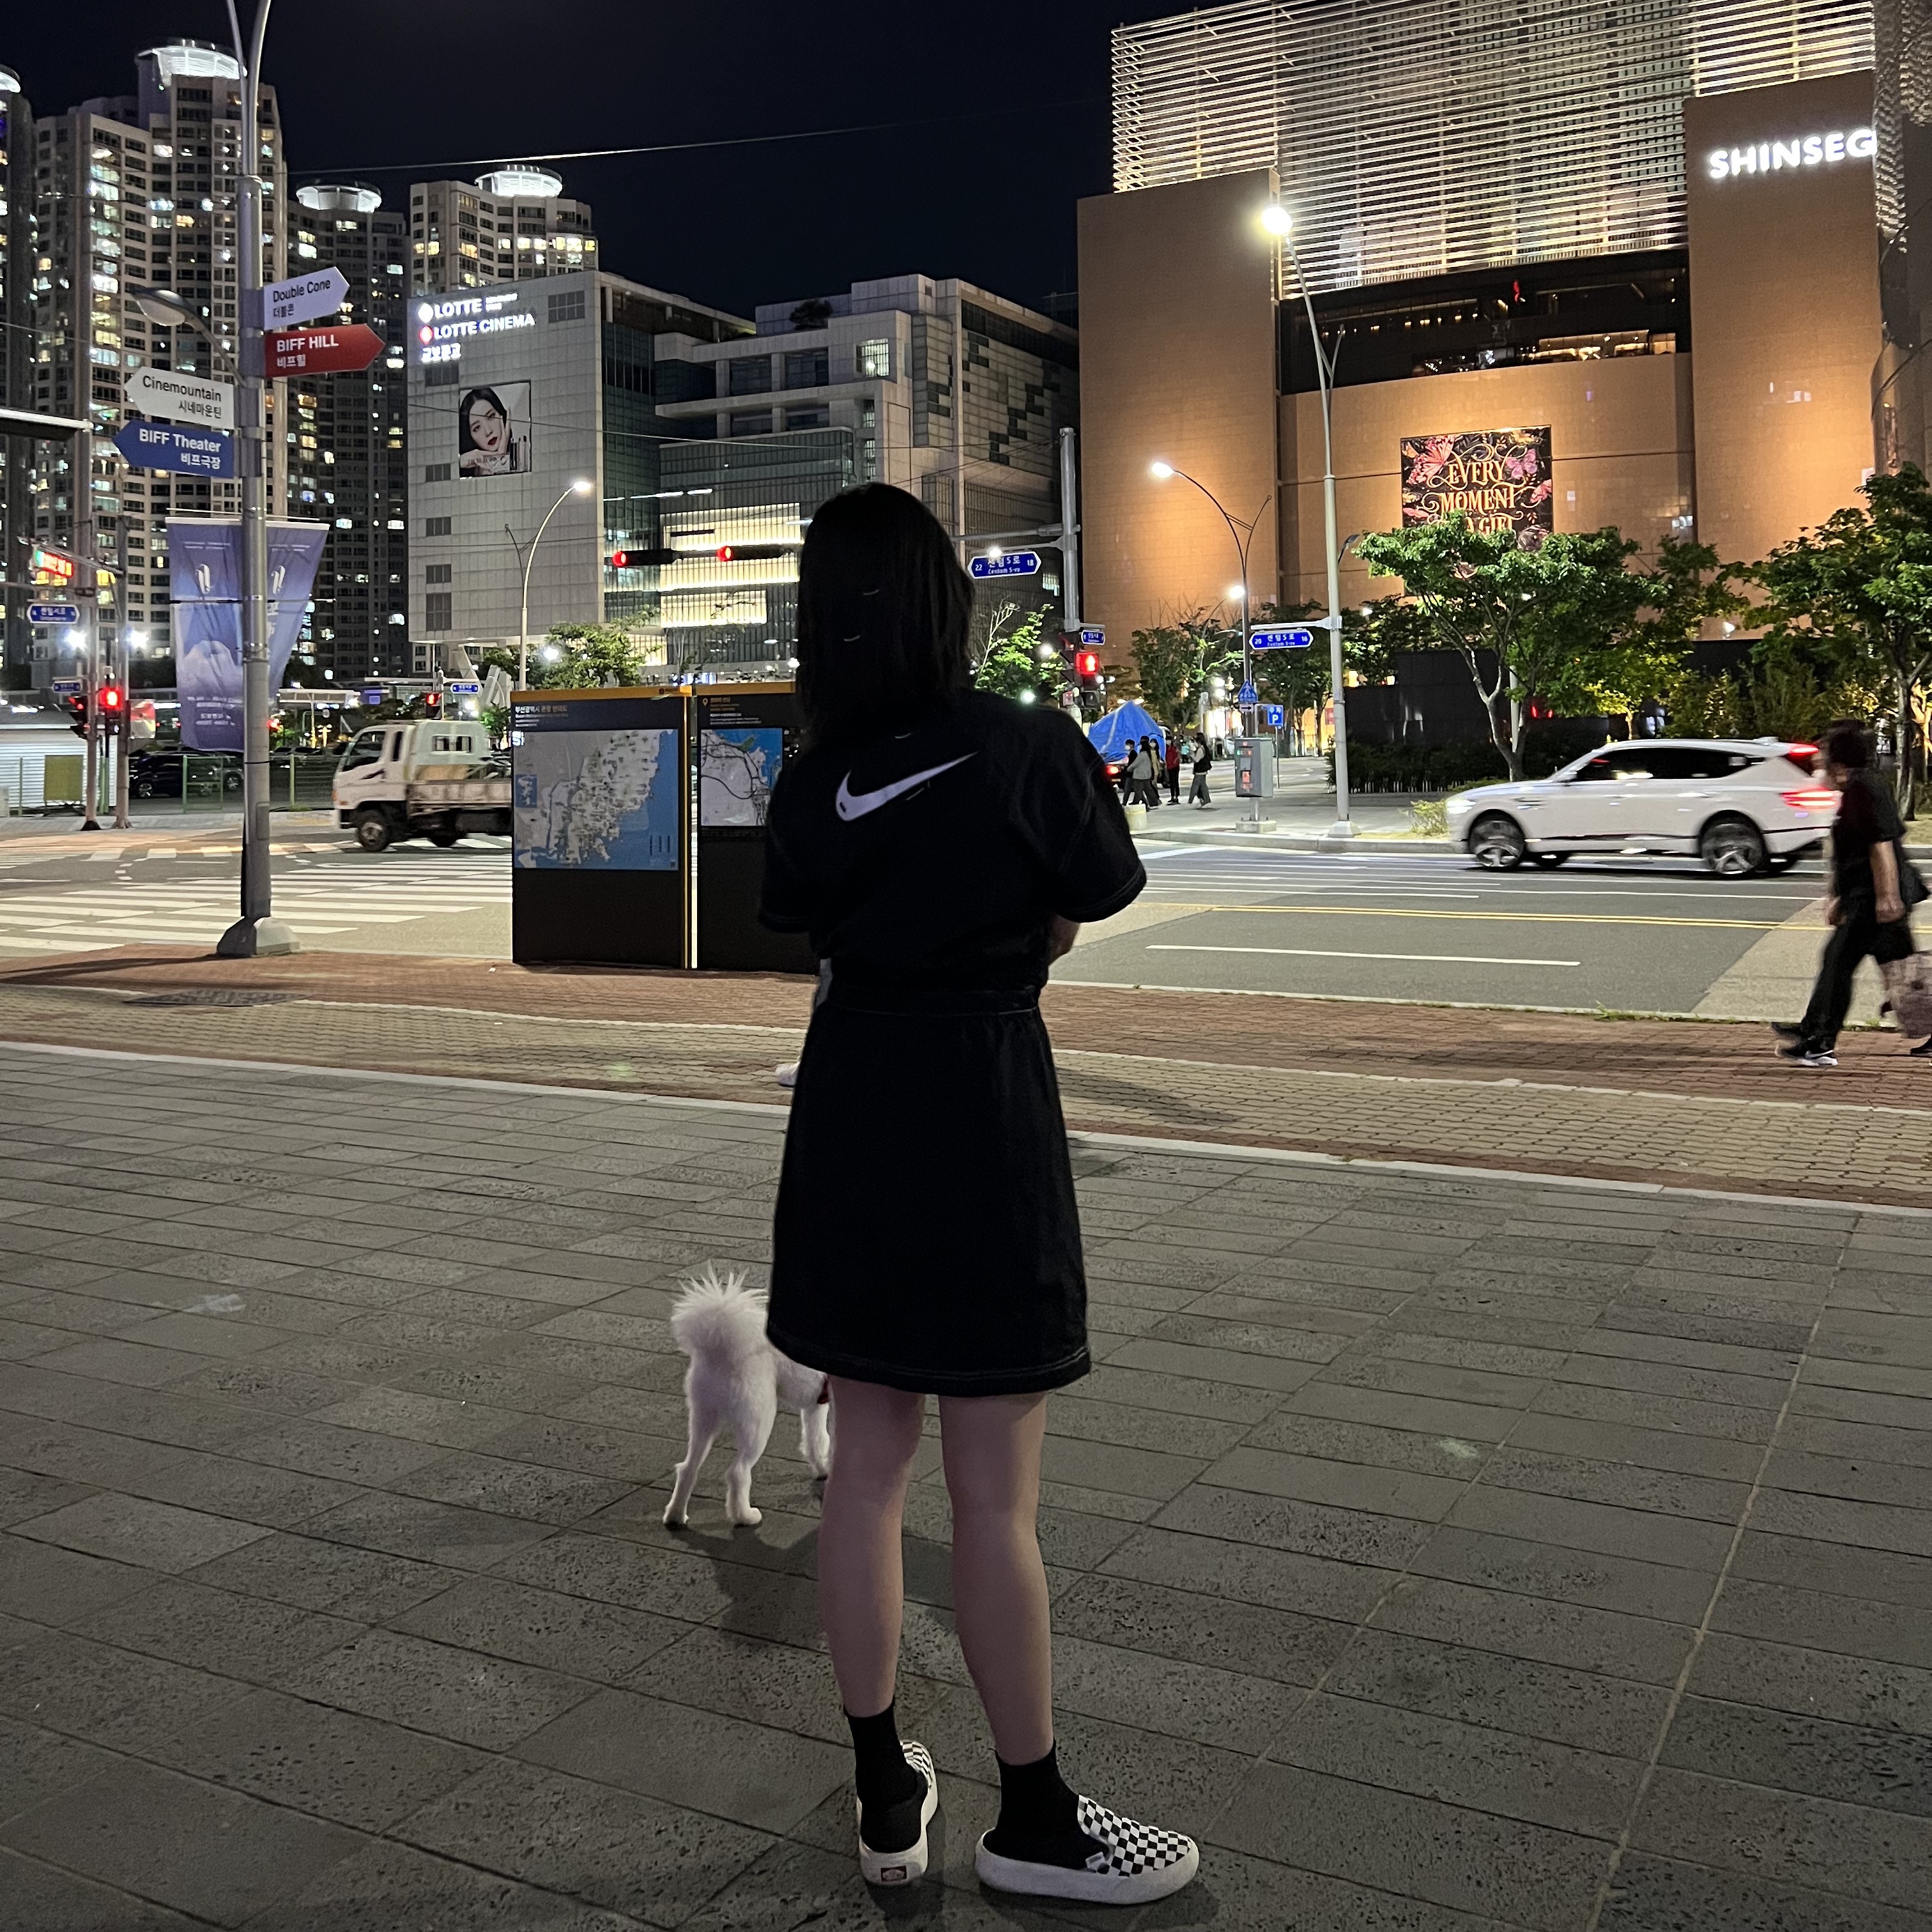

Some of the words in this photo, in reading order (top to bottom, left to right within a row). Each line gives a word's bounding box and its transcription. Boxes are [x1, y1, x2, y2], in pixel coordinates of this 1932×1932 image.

[273, 285, 304, 302] Double
[307, 280, 330, 293] Cone
[273, 303, 294, 318] 더블콘
[434, 298, 482, 319] LOTTE
[434, 321, 477, 339] LOTTE
[479, 313, 535, 333] CINEMA
[277, 338, 305, 352] BIFF
[309, 335, 339, 349] HILL
[277, 355, 306, 369] 비프힐
[142, 375, 221, 402] Cinemountain
[179, 400, 222, 419] 시네마운틴
[139, 428, 170, 445] BIFF
[172, 434, 221, 452] Theater
[181, 452, 220, 470] 비프극장
[1441, 449, 1514, 488] EVERY
[1435, 483, 1523, 516] MOMENT
[1272, 714, 1279, 724] P
